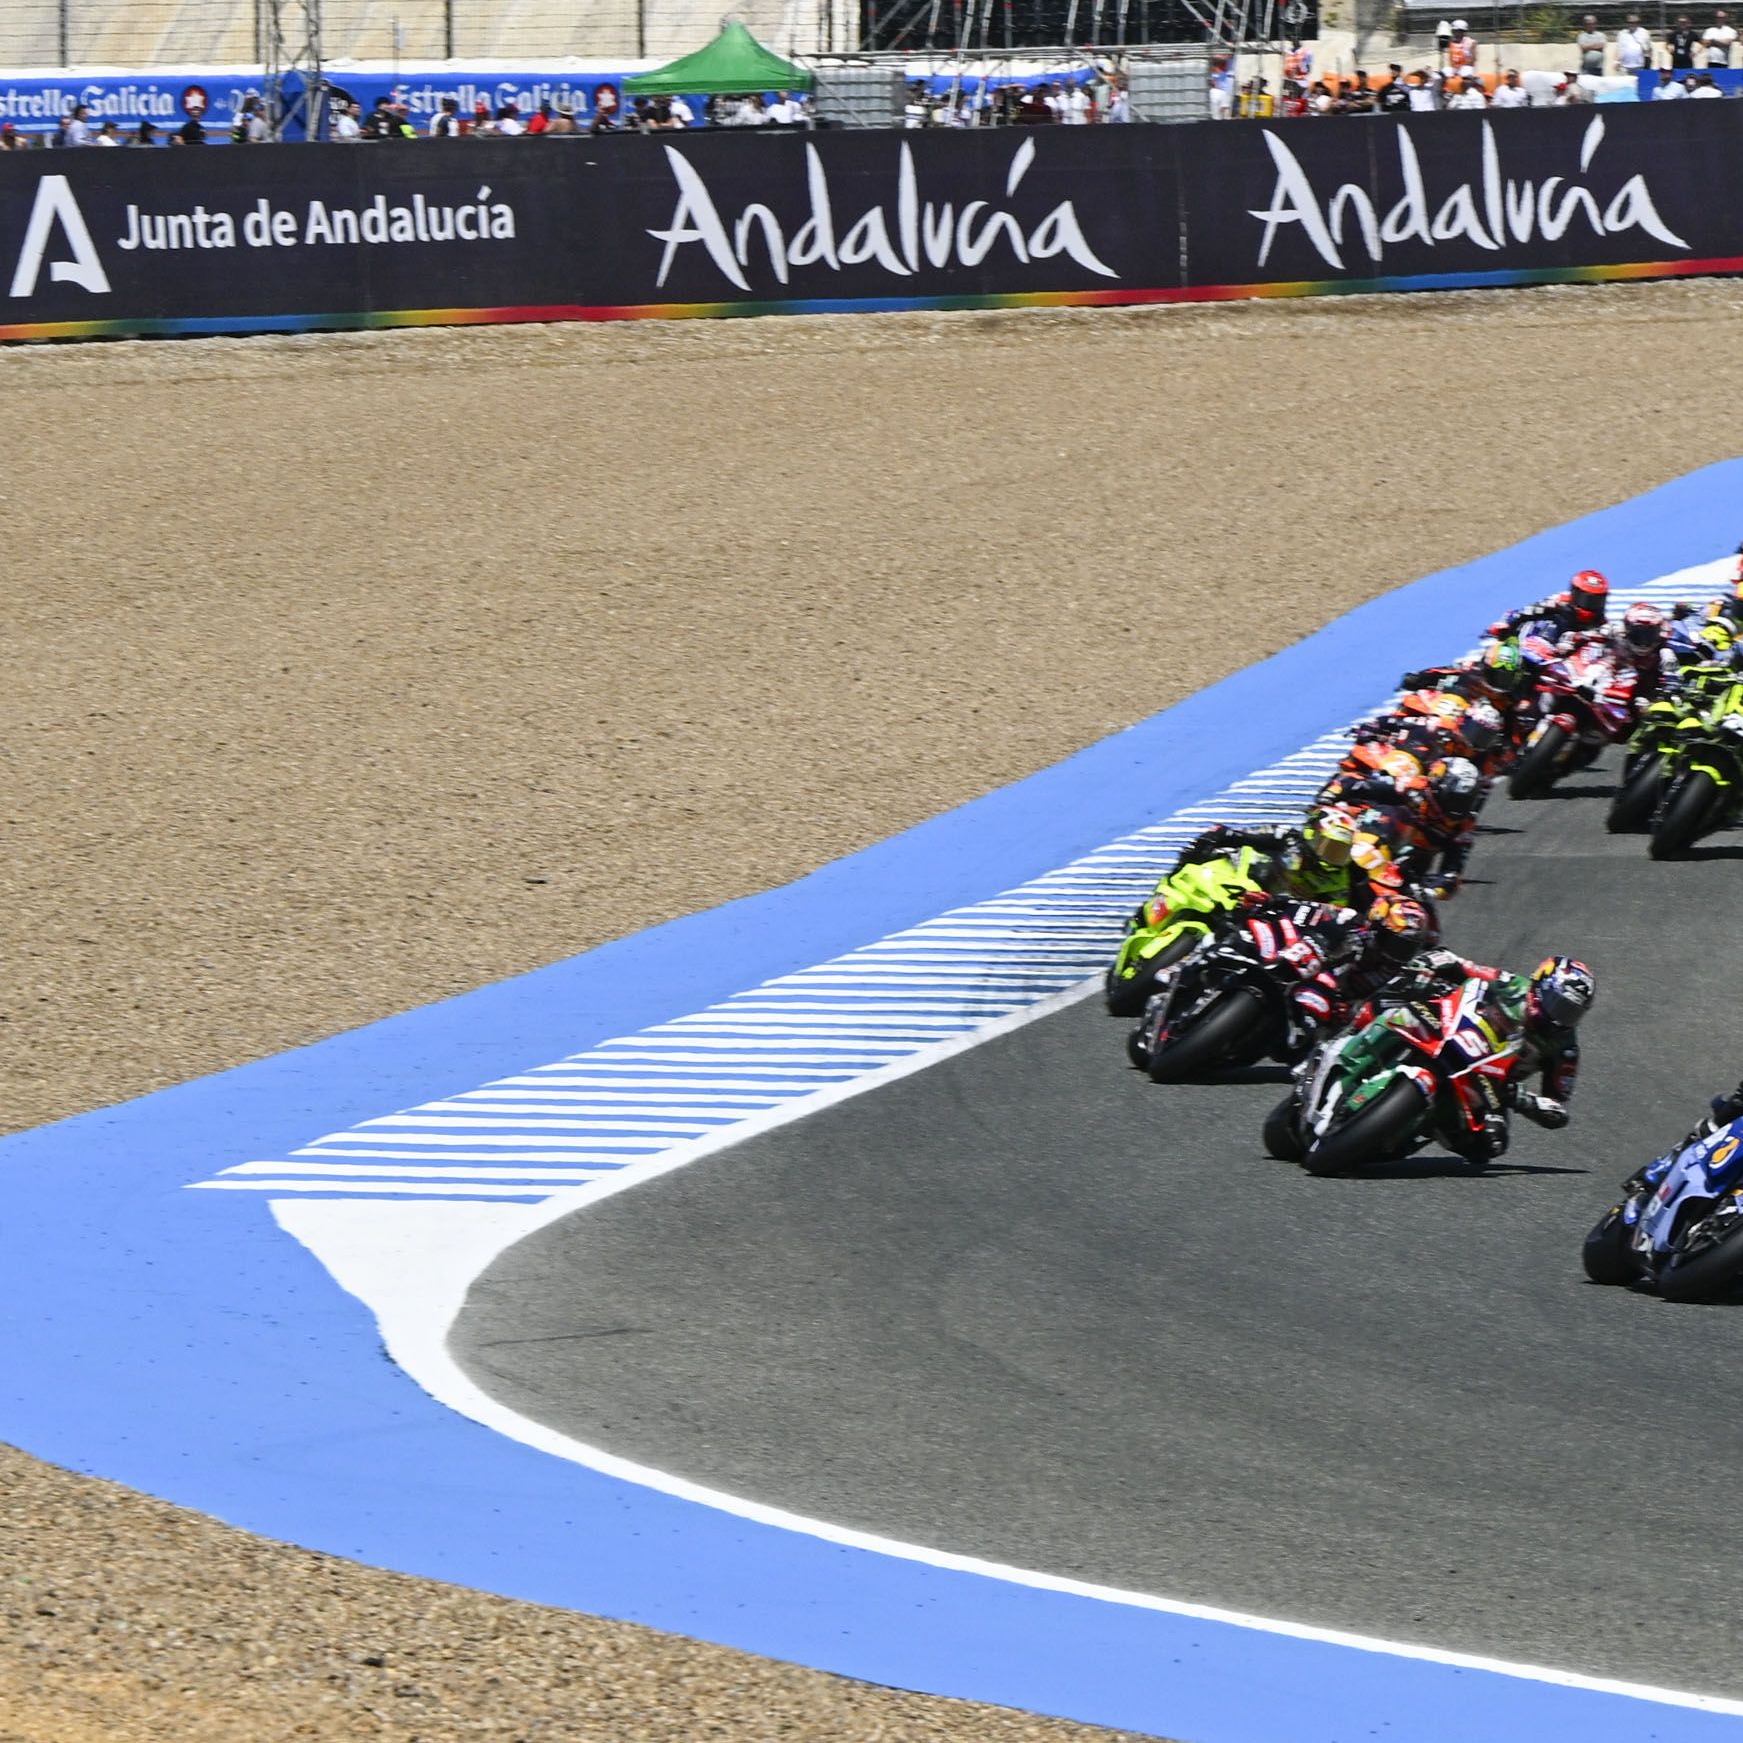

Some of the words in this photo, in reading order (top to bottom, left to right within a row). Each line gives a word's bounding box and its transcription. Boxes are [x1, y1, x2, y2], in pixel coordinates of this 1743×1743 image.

[81, 85, 175, 117] Galicia
[118, 203, 235, 251] Junta
[243, 198, 294, 247] de
[305, 185, 516, 245] Andalucía
[646, 136, 1120, 291] Andalucía
[1246, 114, 1693, 270] Andalucía
